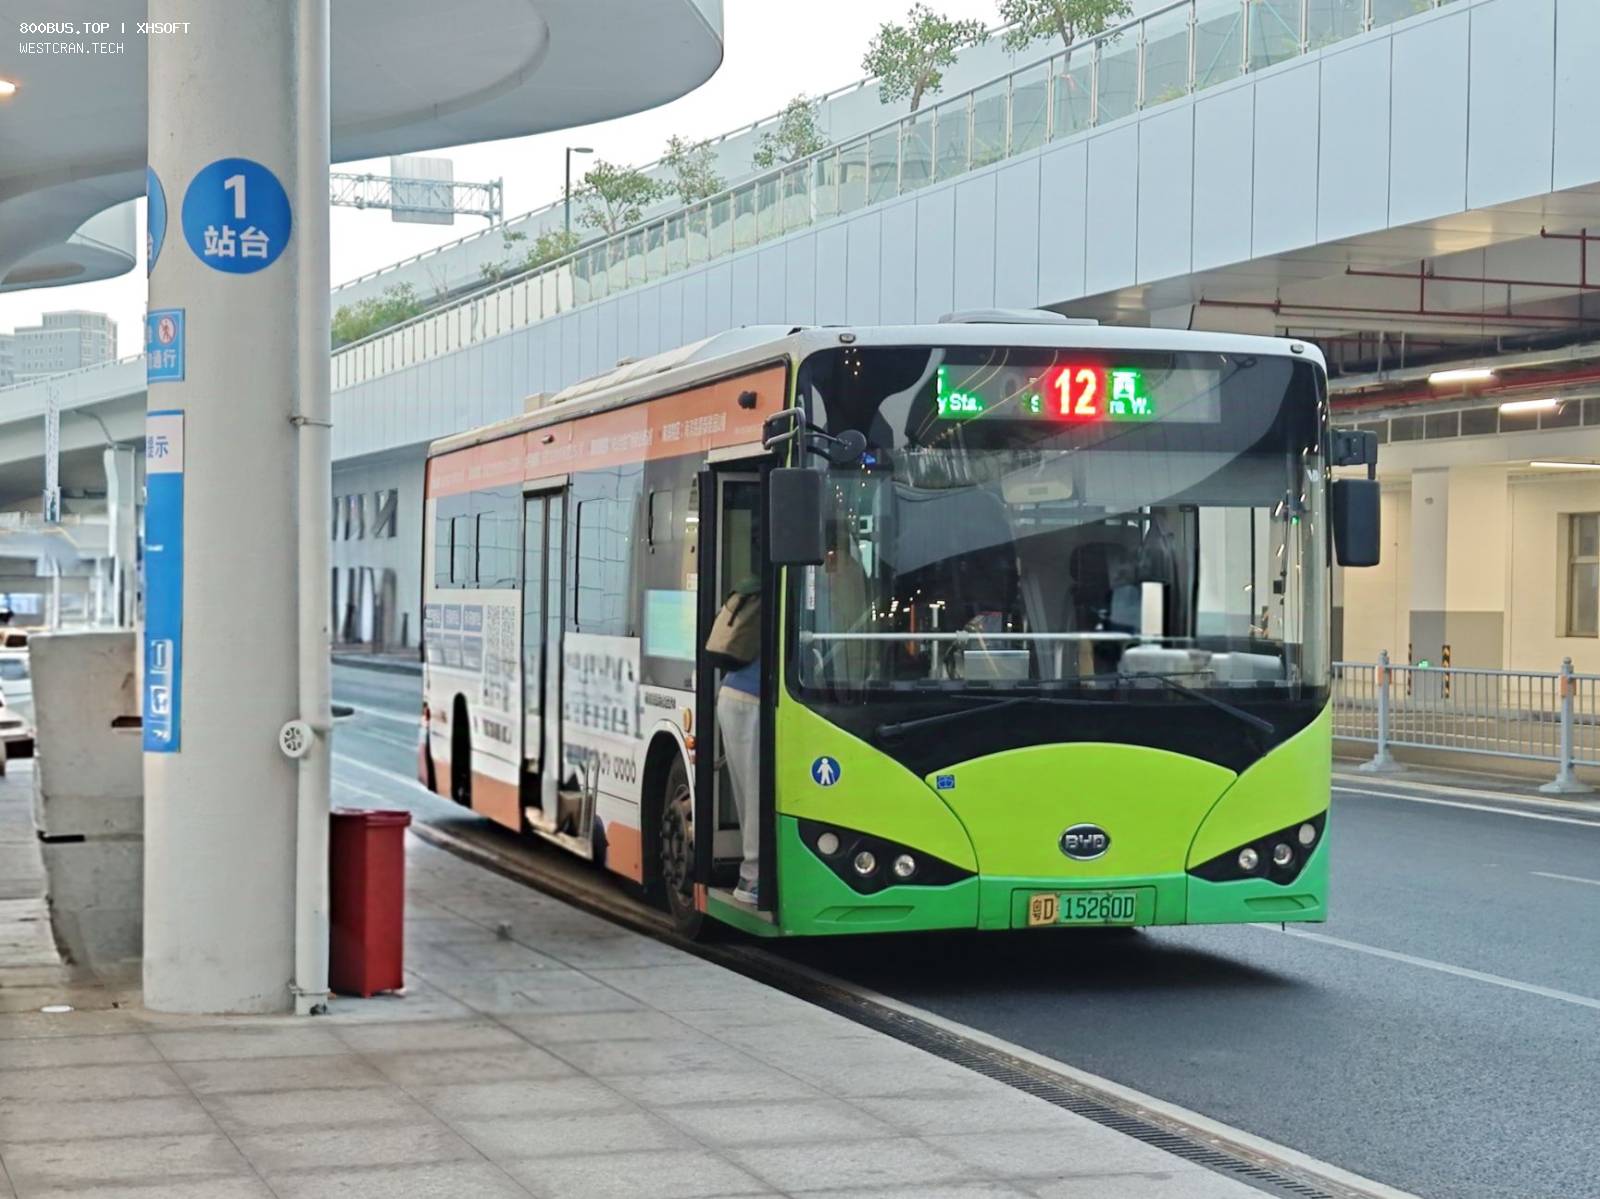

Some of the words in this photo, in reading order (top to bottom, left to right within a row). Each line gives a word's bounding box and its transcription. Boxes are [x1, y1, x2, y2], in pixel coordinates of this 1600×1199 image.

[223, 174, 247, 219] 1
[204, 225, 270, 258] 站台
[1054, 368, 1097, 415] 12
[1065, 834, 1105, 849] BYD
[1065, 896, 1135, 919] 15260D
